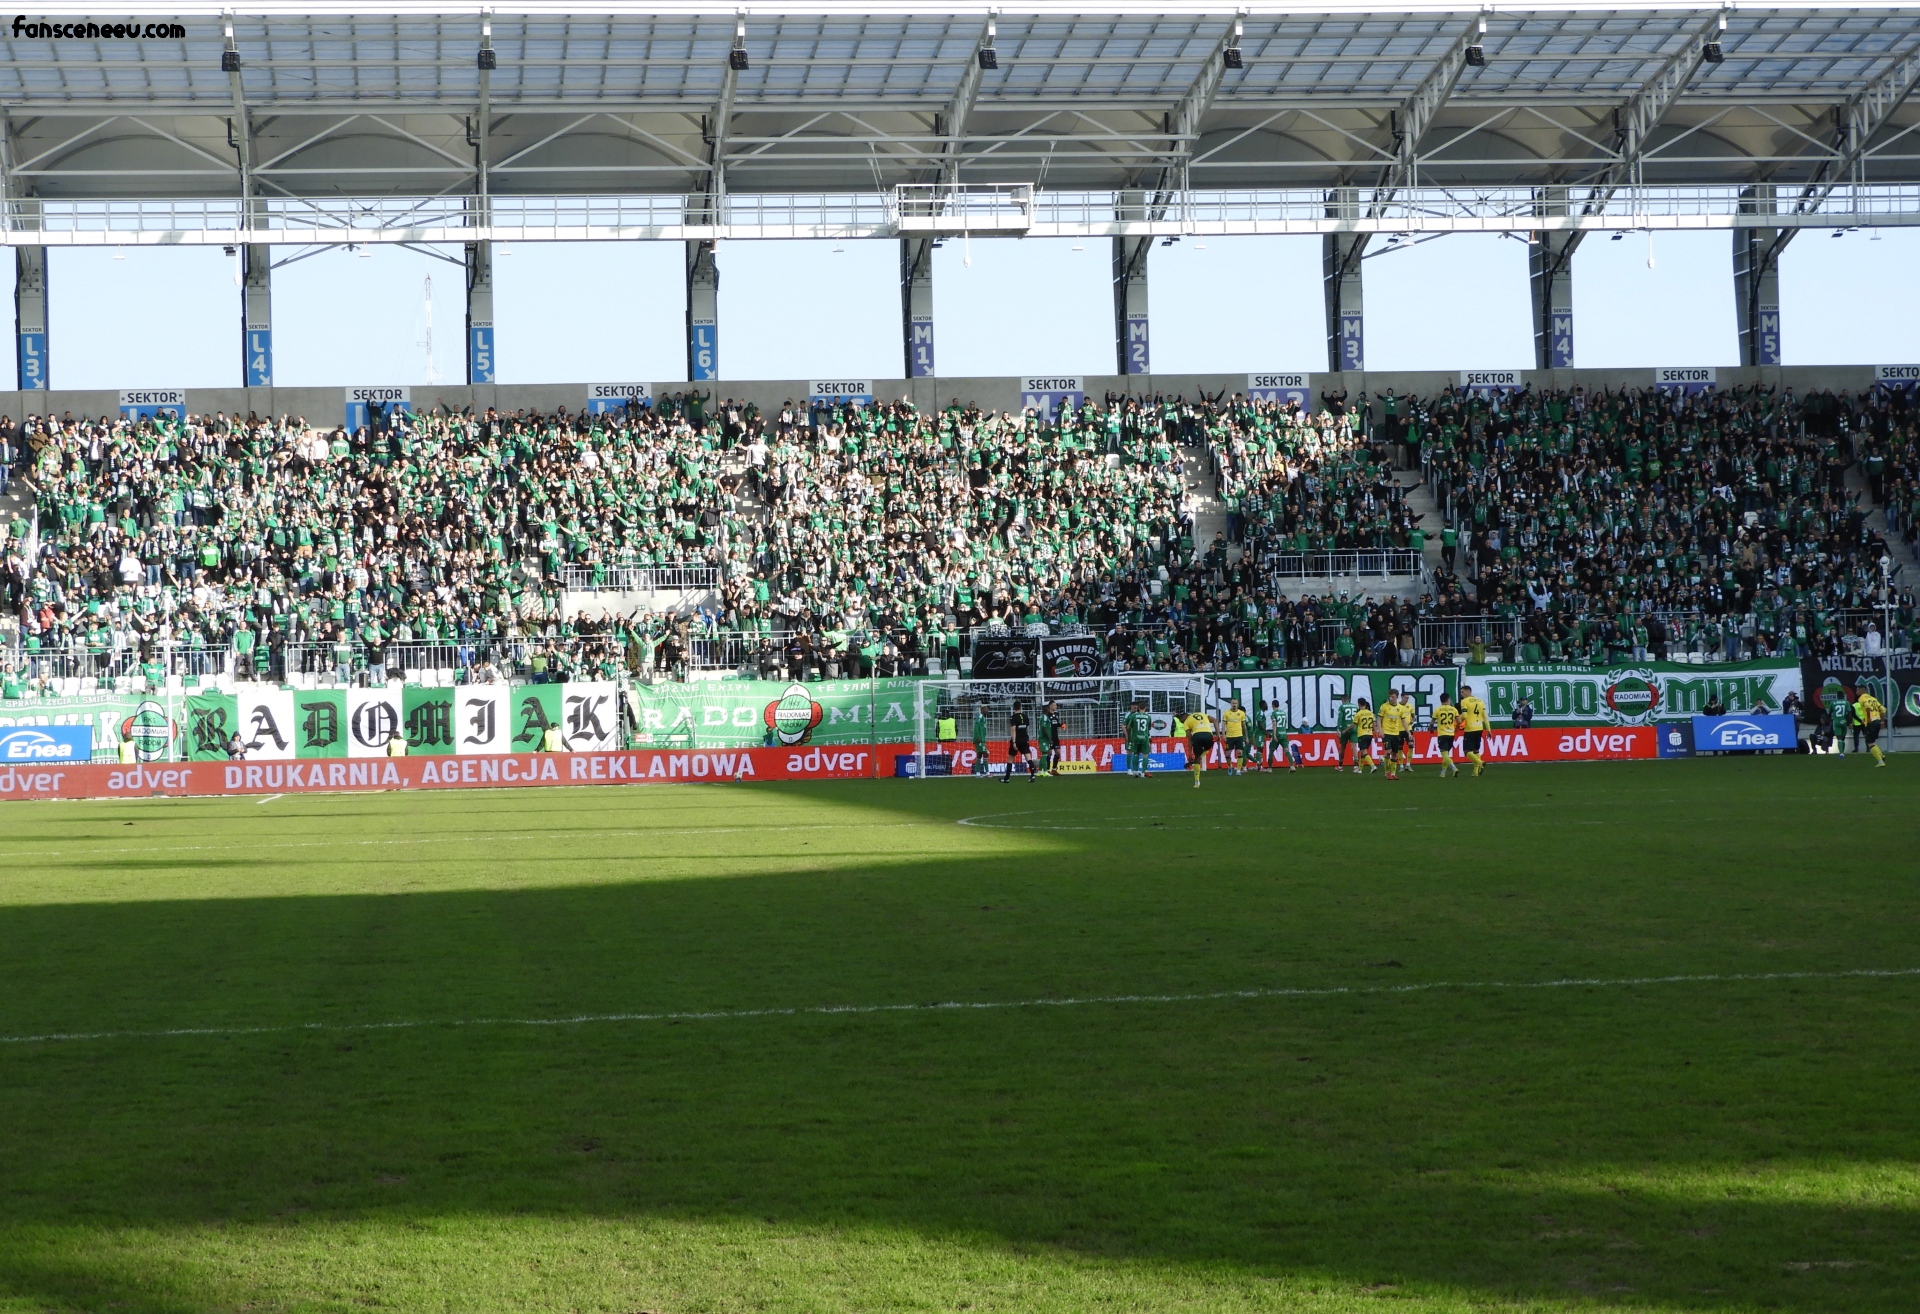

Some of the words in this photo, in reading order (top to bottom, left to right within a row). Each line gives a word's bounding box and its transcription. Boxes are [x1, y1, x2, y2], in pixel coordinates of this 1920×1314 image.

[1254, 375, 1303, 387] SEKTOR
[1662, 370, 1709, 381] SEKTOR
[595, 385, 645, 397] SEKTOR
[816, 382, 866, 394] SEKTOR
[1028, 379, 1077, 390] SEKTOR
[127, 391, 178, 404] SEKTOR
[353, 388, 403, 401] SEKTOR
[1624, 682, 1639, 690] RKS
[1614, 693, 1651, 701] RADOMIAK
[1473, 703, 1480, 715] 4
[1834, 704, 1846, 718] 21
[1135, 718, 1148, 732] 13
[1276, 715, 1287, 728] 27
[1361, 717, 1374, 730] 22
[1439, 712, 1454, 725] 23
[1557, 728, 1637, 753] adver
[1720, 730, 1779, 746] Enea
[7, 740, 73, 758] Enea
[786, 747, 869, 772] adver
[107, 764, 193, 790] adver
[225, 761, 410, 788] DRUKARNIA,
[421, 756, 559, 784] AGENCJA
[570, 753, 756, 781] REKLAMOWA
